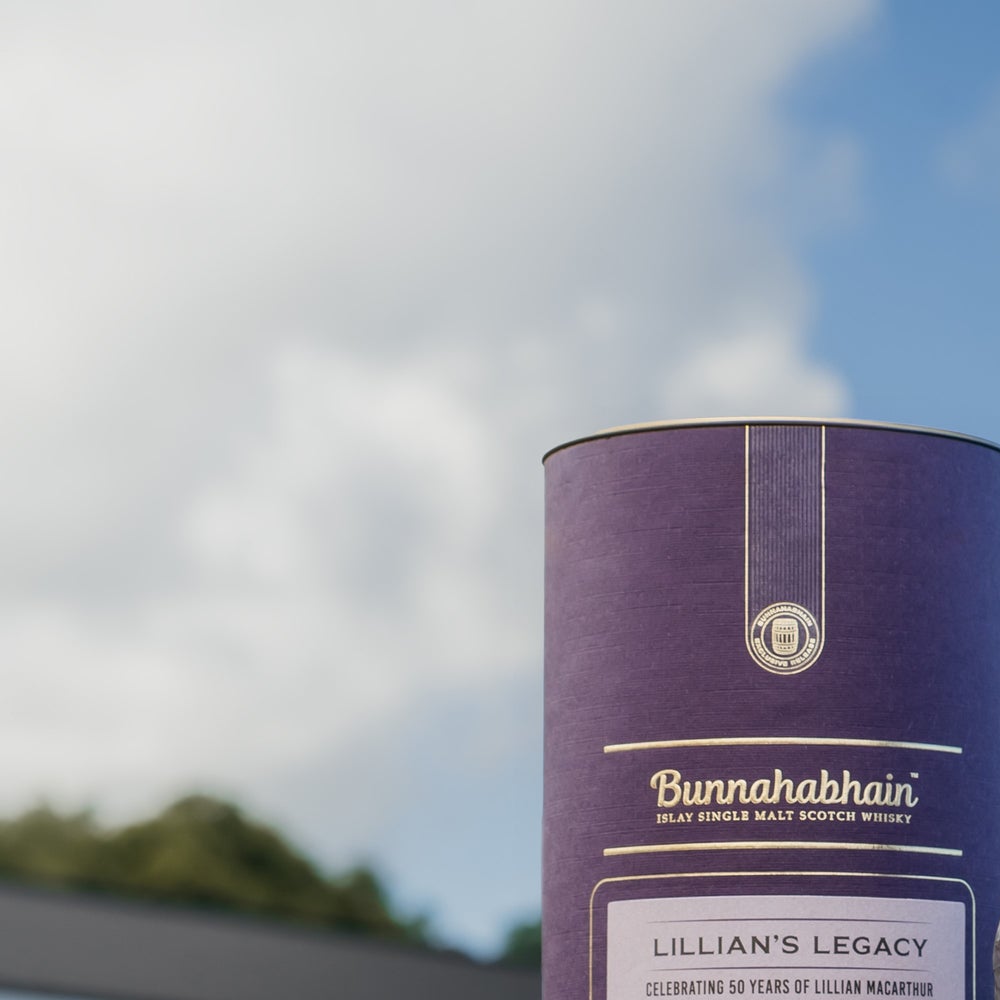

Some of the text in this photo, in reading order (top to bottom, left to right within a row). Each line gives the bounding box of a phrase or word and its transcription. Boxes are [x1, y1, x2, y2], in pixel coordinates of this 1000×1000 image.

[650, 769, 919, 808] Bunnahabhain
[656, 810, 912, 824] ISLAY SINGLE MALT SCOTCH WHISKY
[654, 934, 928, 957] LILLIAN'S LEGACY
[646, 979, 934, 997] CELEBRATING 50 YEARS OF LILLIAN MACARTHUR
